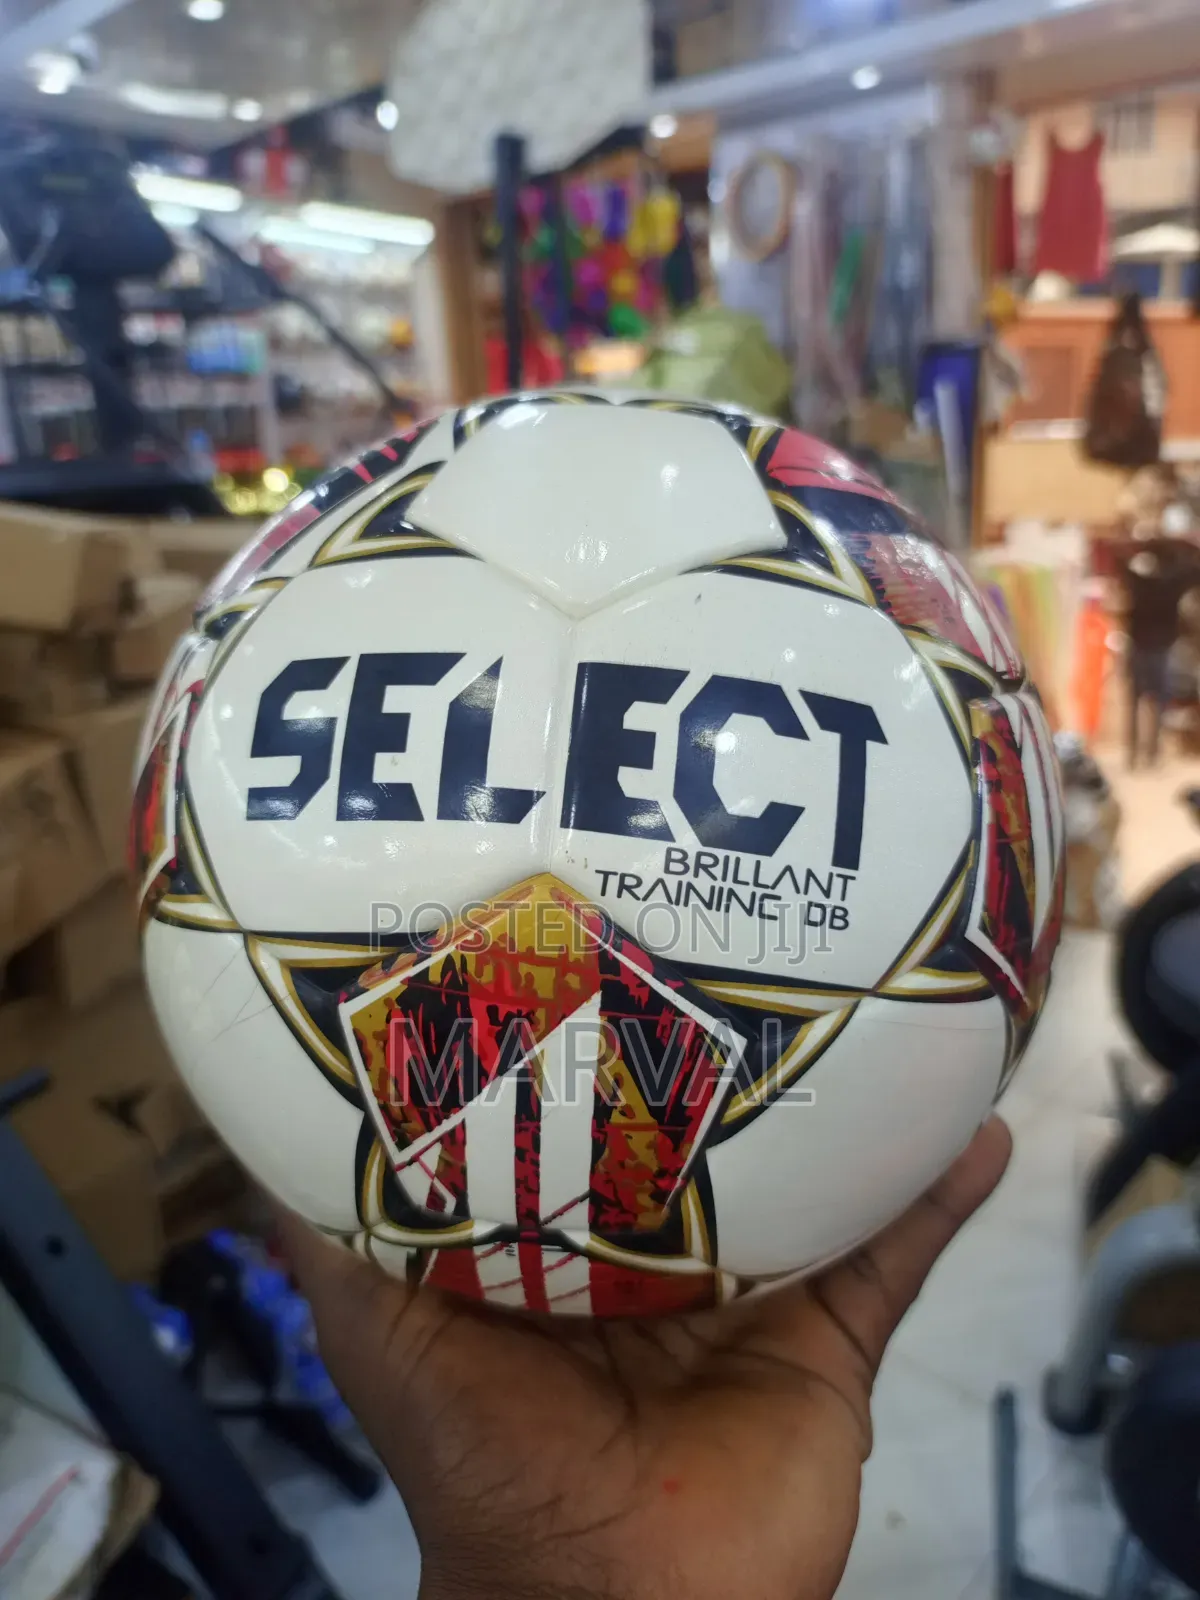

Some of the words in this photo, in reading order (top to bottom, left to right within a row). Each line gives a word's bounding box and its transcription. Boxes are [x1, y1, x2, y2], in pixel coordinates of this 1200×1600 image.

[246, 652, 888, 871] SELECT
[664, 847, 856, 901] BRILLANT
[804, 901, 850, 931] DB
